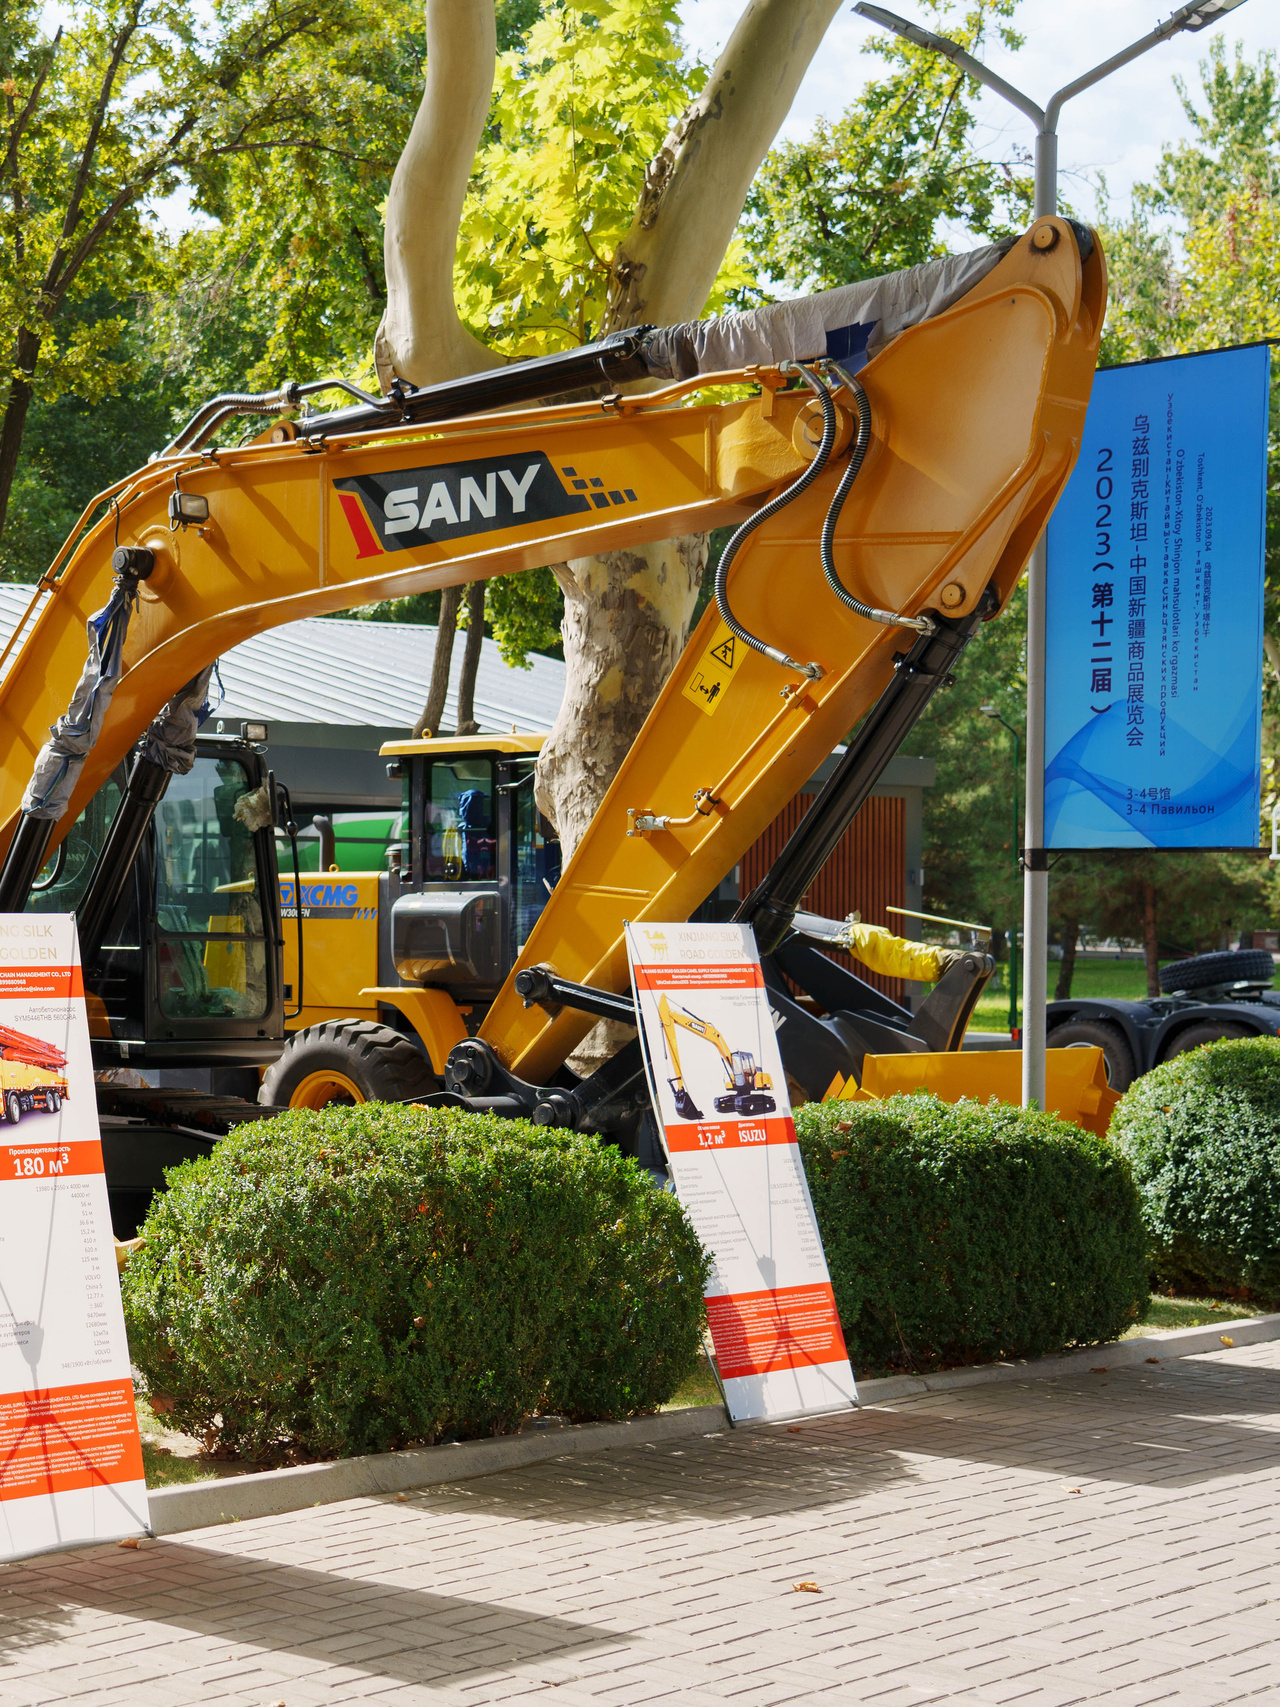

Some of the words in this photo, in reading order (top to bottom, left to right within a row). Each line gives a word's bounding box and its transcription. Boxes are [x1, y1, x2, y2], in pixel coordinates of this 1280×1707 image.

[384, 463, 541, 535] SANY
[1126, 787, 1171, 801] 3-4号馆
[1126, 803, 1146, 815] 3-4
[1151, 803, 1215, 815] Павильон
[296, 884, 359, 906] XCMG
[23, 924, 53, 936] SILK
[720, 932, 740, 942] SILK
[680, 949, 705, 959] ROAD
[697, 1132, 714, 1147] 1,2
[737, 1128, 767, 1142] ISUZU
[8, 1144, 71, 1156] Производительность
[12, 1156, 45, 1176] 180
